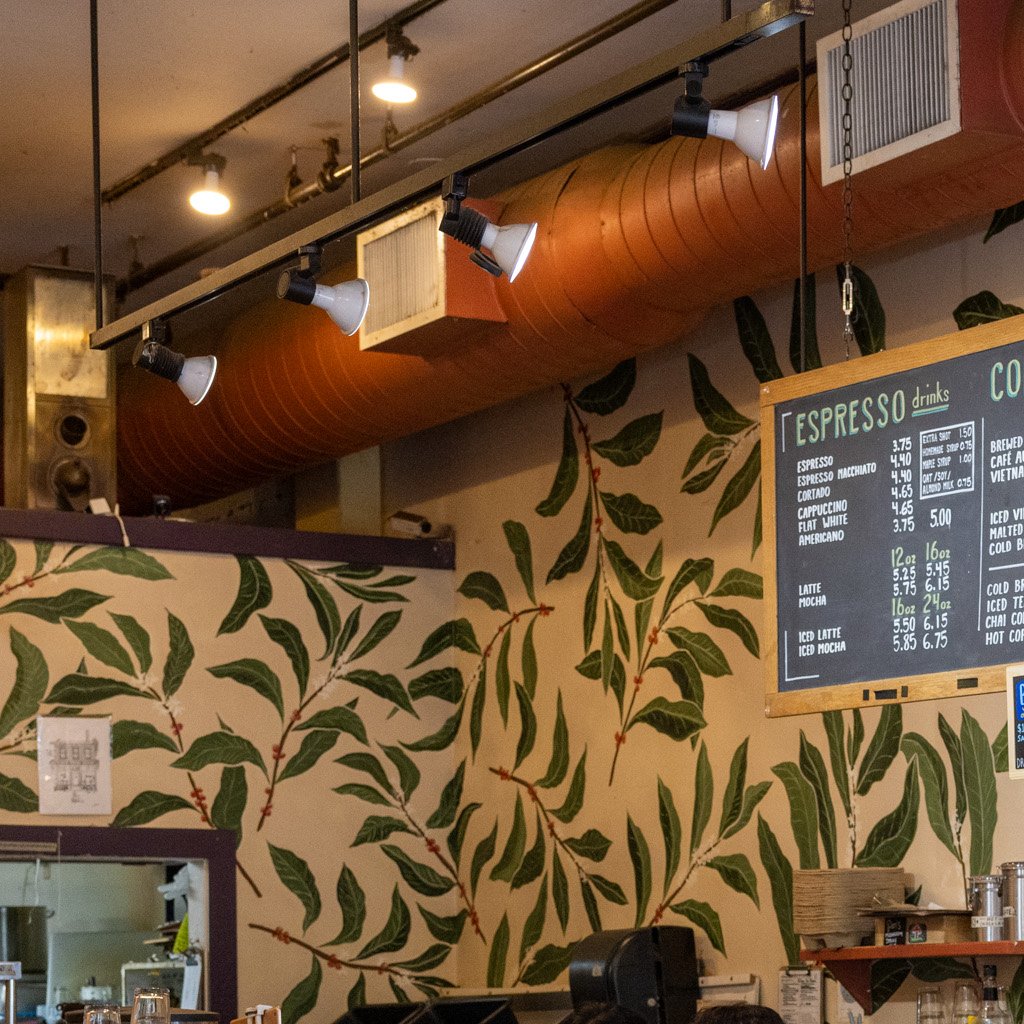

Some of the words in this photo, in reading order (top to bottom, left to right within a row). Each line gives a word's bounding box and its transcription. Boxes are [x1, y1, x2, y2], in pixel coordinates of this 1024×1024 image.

[796, 390, 906, 446] ESPRESSO
[912, 381, 949, 408] drinks
[991, 437, 1023, 453] BREWED
[798, 456, 833, 473] ESPRESSO
[798, 471, 833, 487] ESPRESSO
[838, 462, 876, 480] MACCHIATO
[798, 487, 830, 502] CORTADO
[798, 500, 847, 519] CAPPUCCINO
[799, 519, 817, 533] FLAT
[823, 514, 848, 528] WHITE
[930, 509, 951, 528] 5.00
[799, 530, 844, 546] AMERICANO
[990, 524, 1023, 540] MALTED
[799, 583, 821, 595] LATTE
[799, 595, 826, 608] MOCHA
[986, 614, 1006, 629] CHAI
